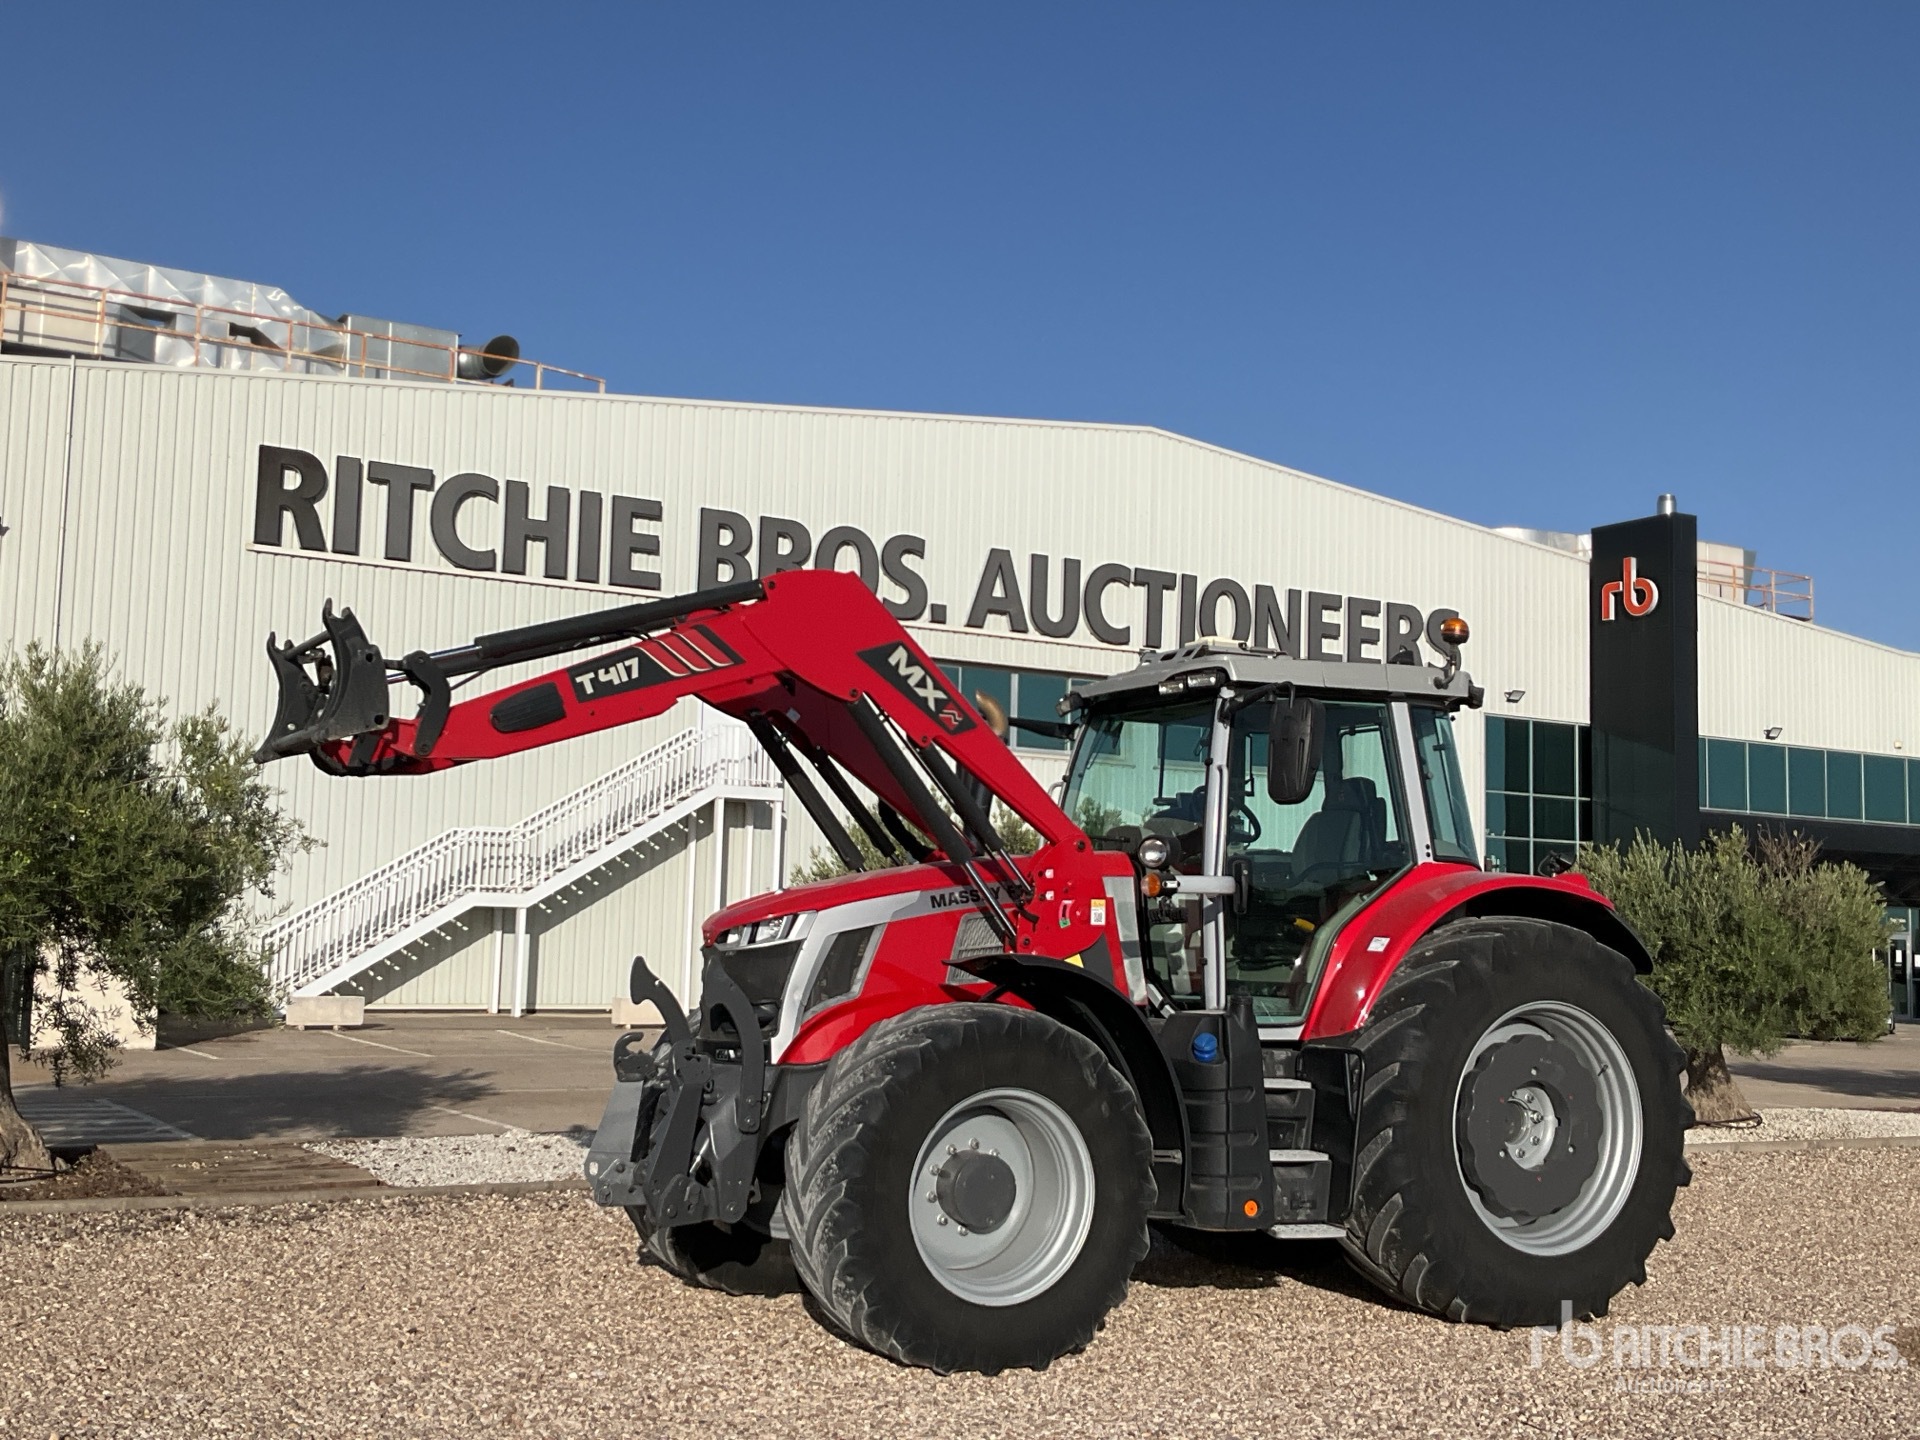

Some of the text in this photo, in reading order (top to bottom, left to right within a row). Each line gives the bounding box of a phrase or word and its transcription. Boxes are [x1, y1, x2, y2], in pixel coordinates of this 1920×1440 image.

[254, 444, 662, 591] RITCHIE
[964, 548, 1462, 672] AUCTIONEERS
[575, 657, 639, 695] T417
[888, 645, 948, 713] MX
[930, 887, 1001, 908] MASSY
